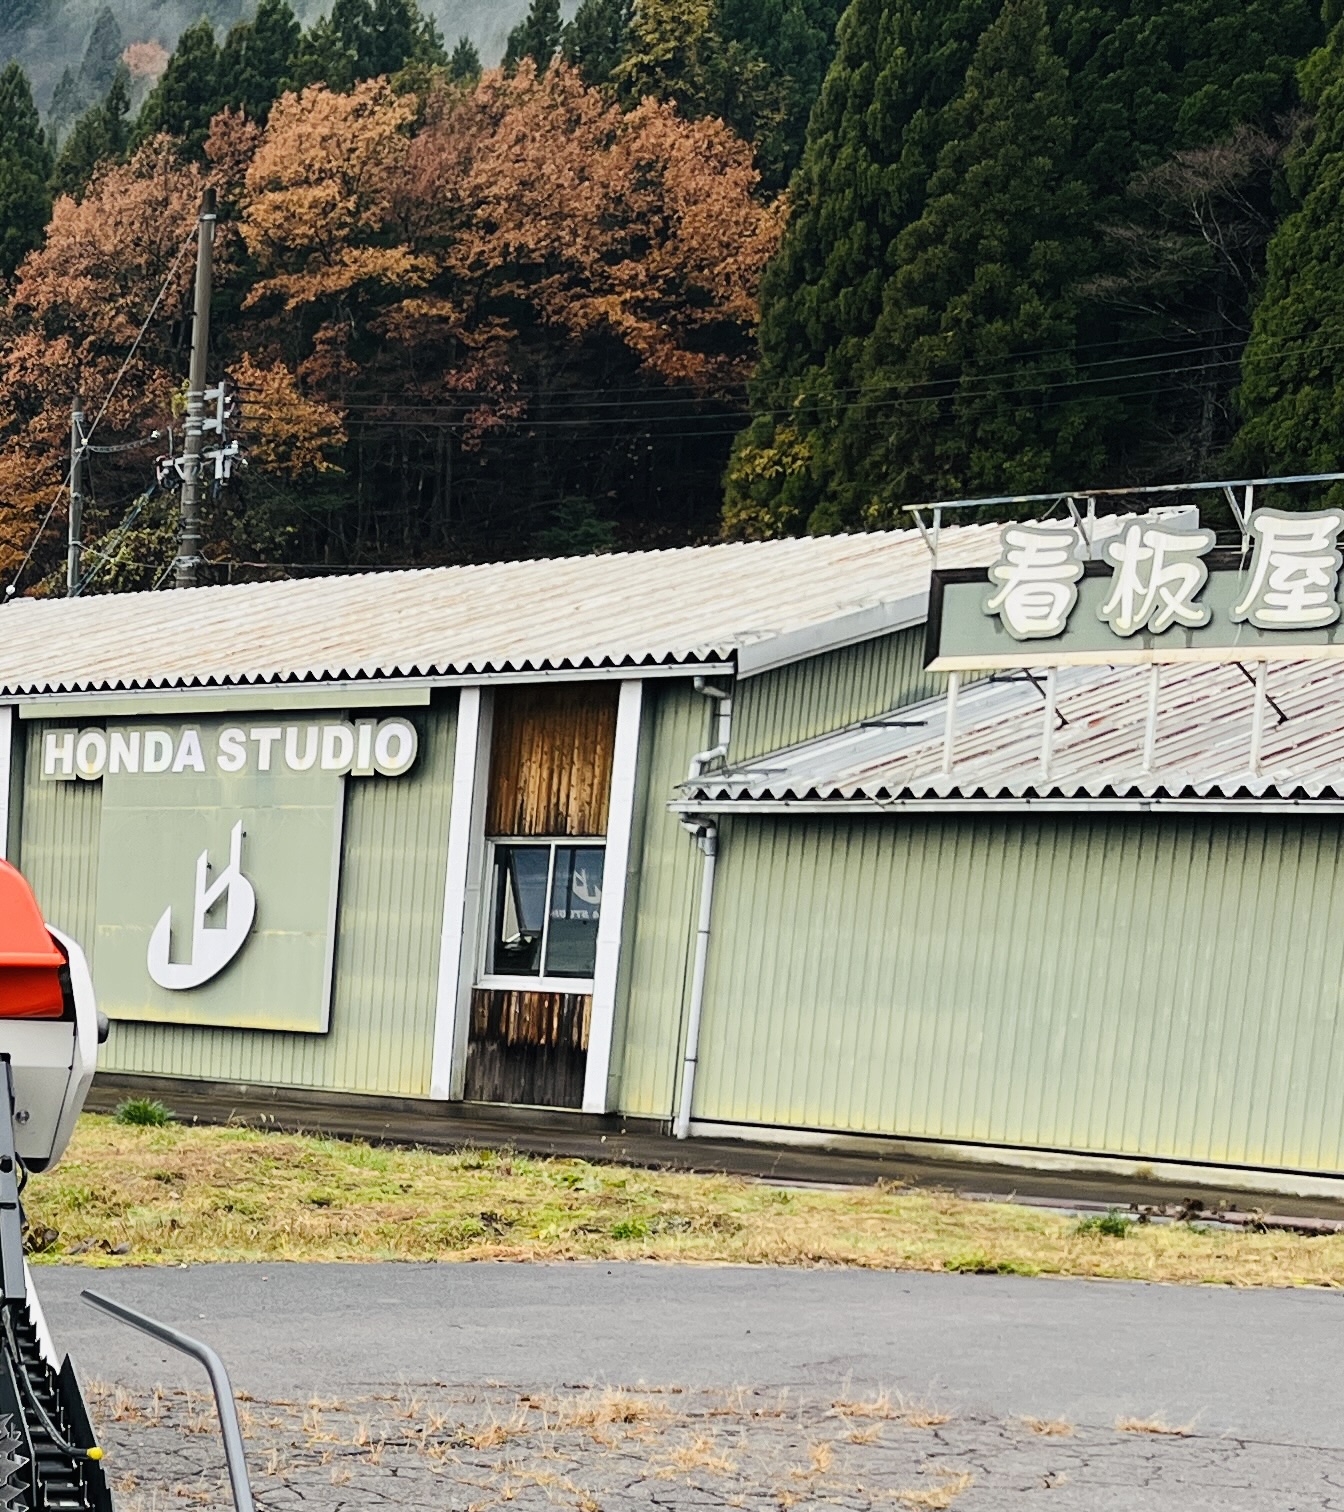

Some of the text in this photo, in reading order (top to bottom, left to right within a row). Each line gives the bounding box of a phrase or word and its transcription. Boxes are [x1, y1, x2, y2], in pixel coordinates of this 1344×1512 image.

[984, 511, 1343, 637] 看板屋
[43, 722, 414, 776] HONDA STUDIO
